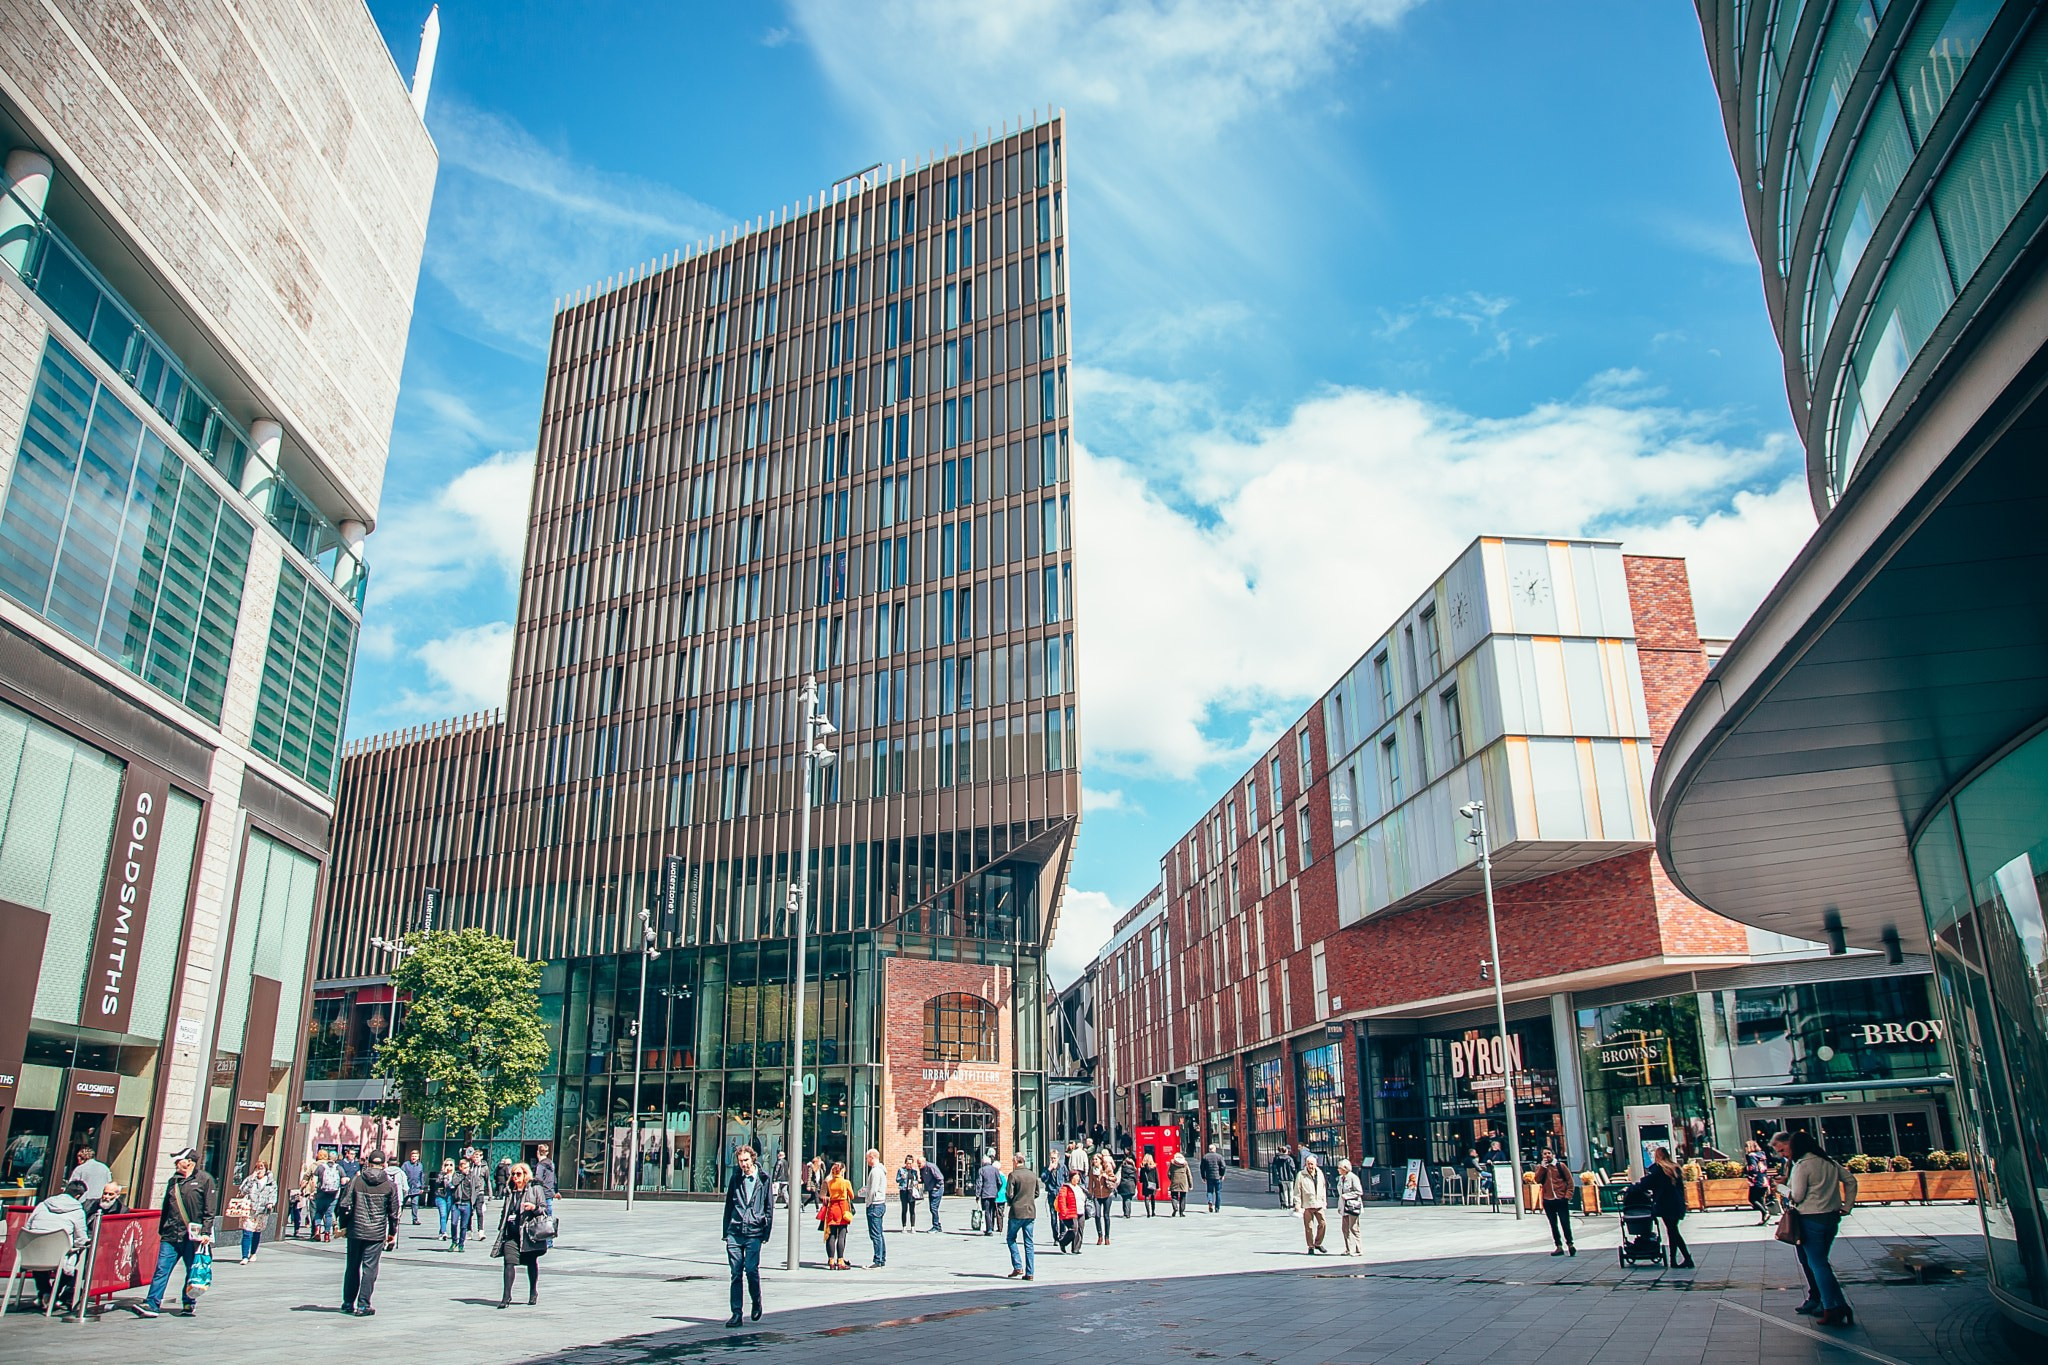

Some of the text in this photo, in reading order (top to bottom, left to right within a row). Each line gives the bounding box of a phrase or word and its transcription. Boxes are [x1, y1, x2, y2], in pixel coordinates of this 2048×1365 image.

[101, 792, 153, 1015] GOLDSMITHS
[1450, 1033, 1522, 1079] BYRON
[1601, 1045, 1658, 1064] BROWNS
[922, 1068, 1000, 1082] URBAN OUTFITTERS
[76, 1082, 115, 1094] GOLDSMITHS
[666, 1111, 691, 1132] UO
